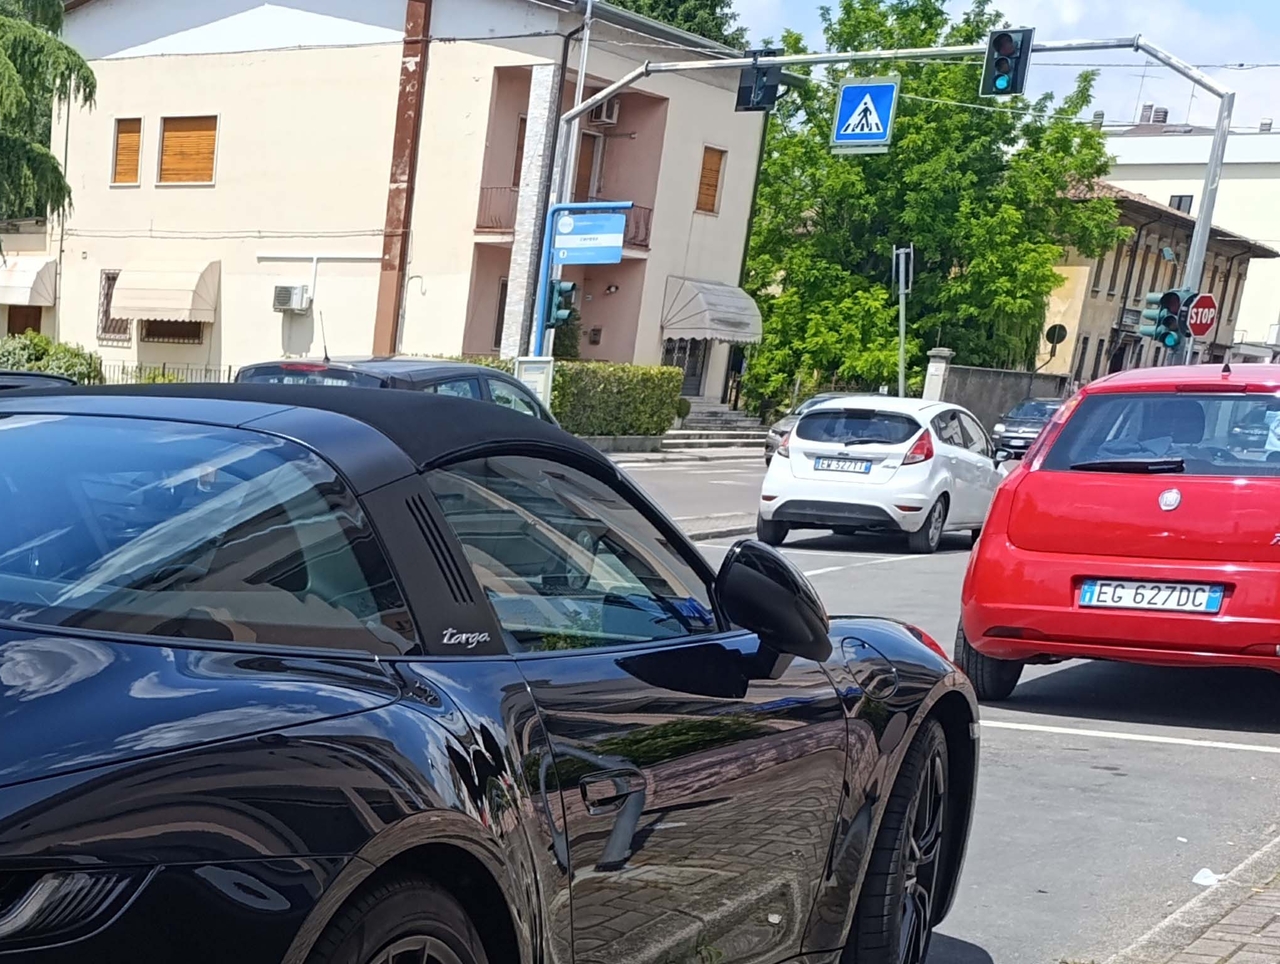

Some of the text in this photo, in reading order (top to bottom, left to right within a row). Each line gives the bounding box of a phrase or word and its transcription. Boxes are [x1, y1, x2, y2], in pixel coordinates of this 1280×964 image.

[1190, 308, 1216, 324] STOP
[1096, 583, 1126, 603] EG
[1133, 585, 1207, 607] 627DC
